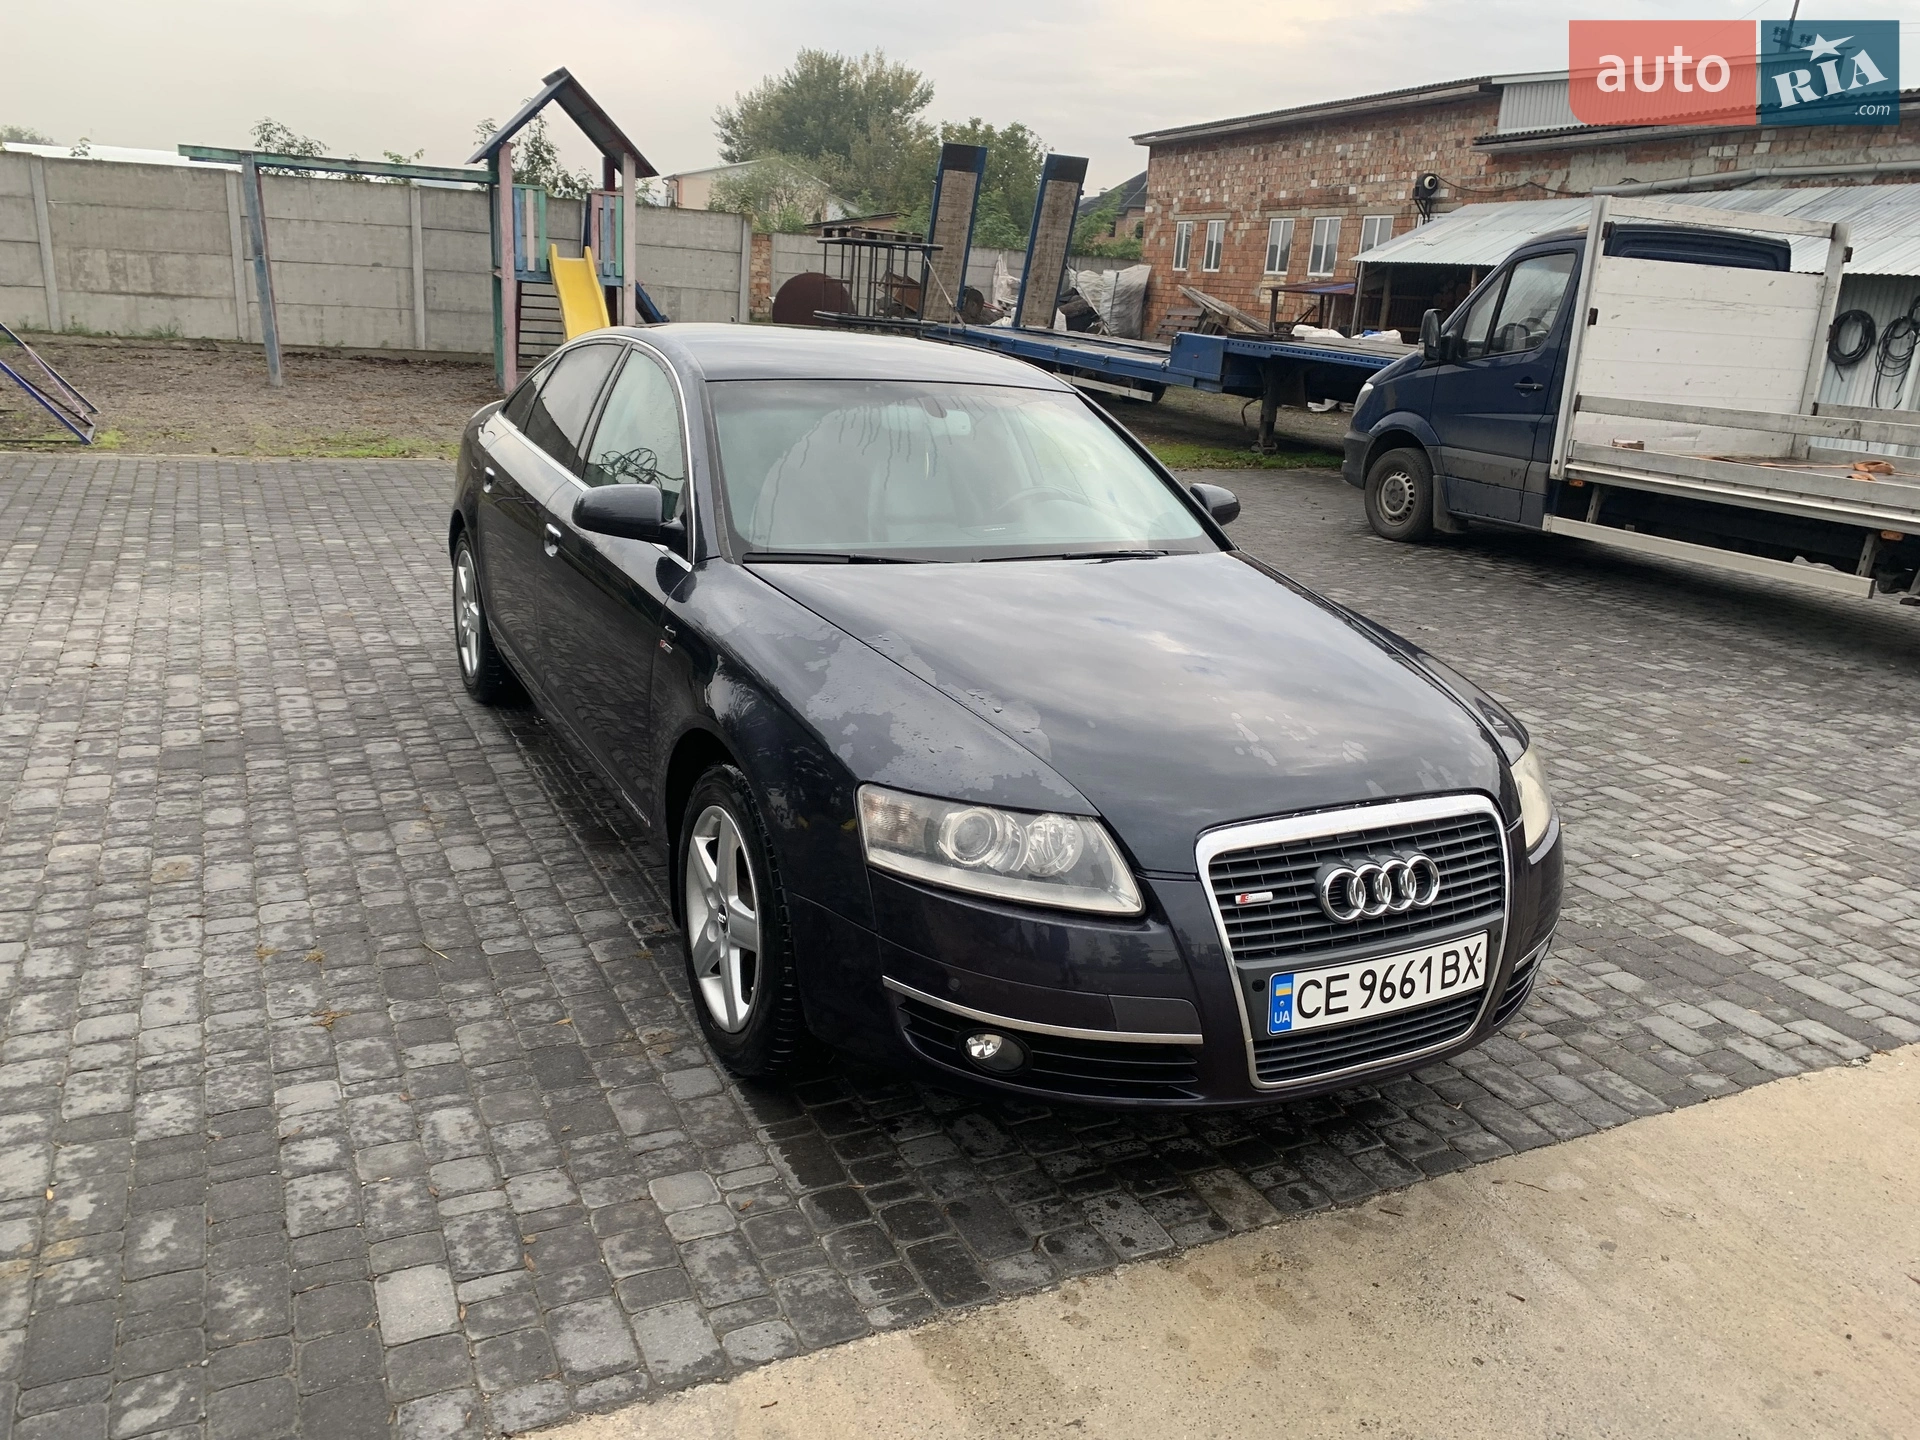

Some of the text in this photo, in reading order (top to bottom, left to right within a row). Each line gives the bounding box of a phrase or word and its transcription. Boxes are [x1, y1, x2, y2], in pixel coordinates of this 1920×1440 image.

[1297, 942, 1482, 1019] CE 9661 BX
[1274, 1010, 1291, 1024] UA
